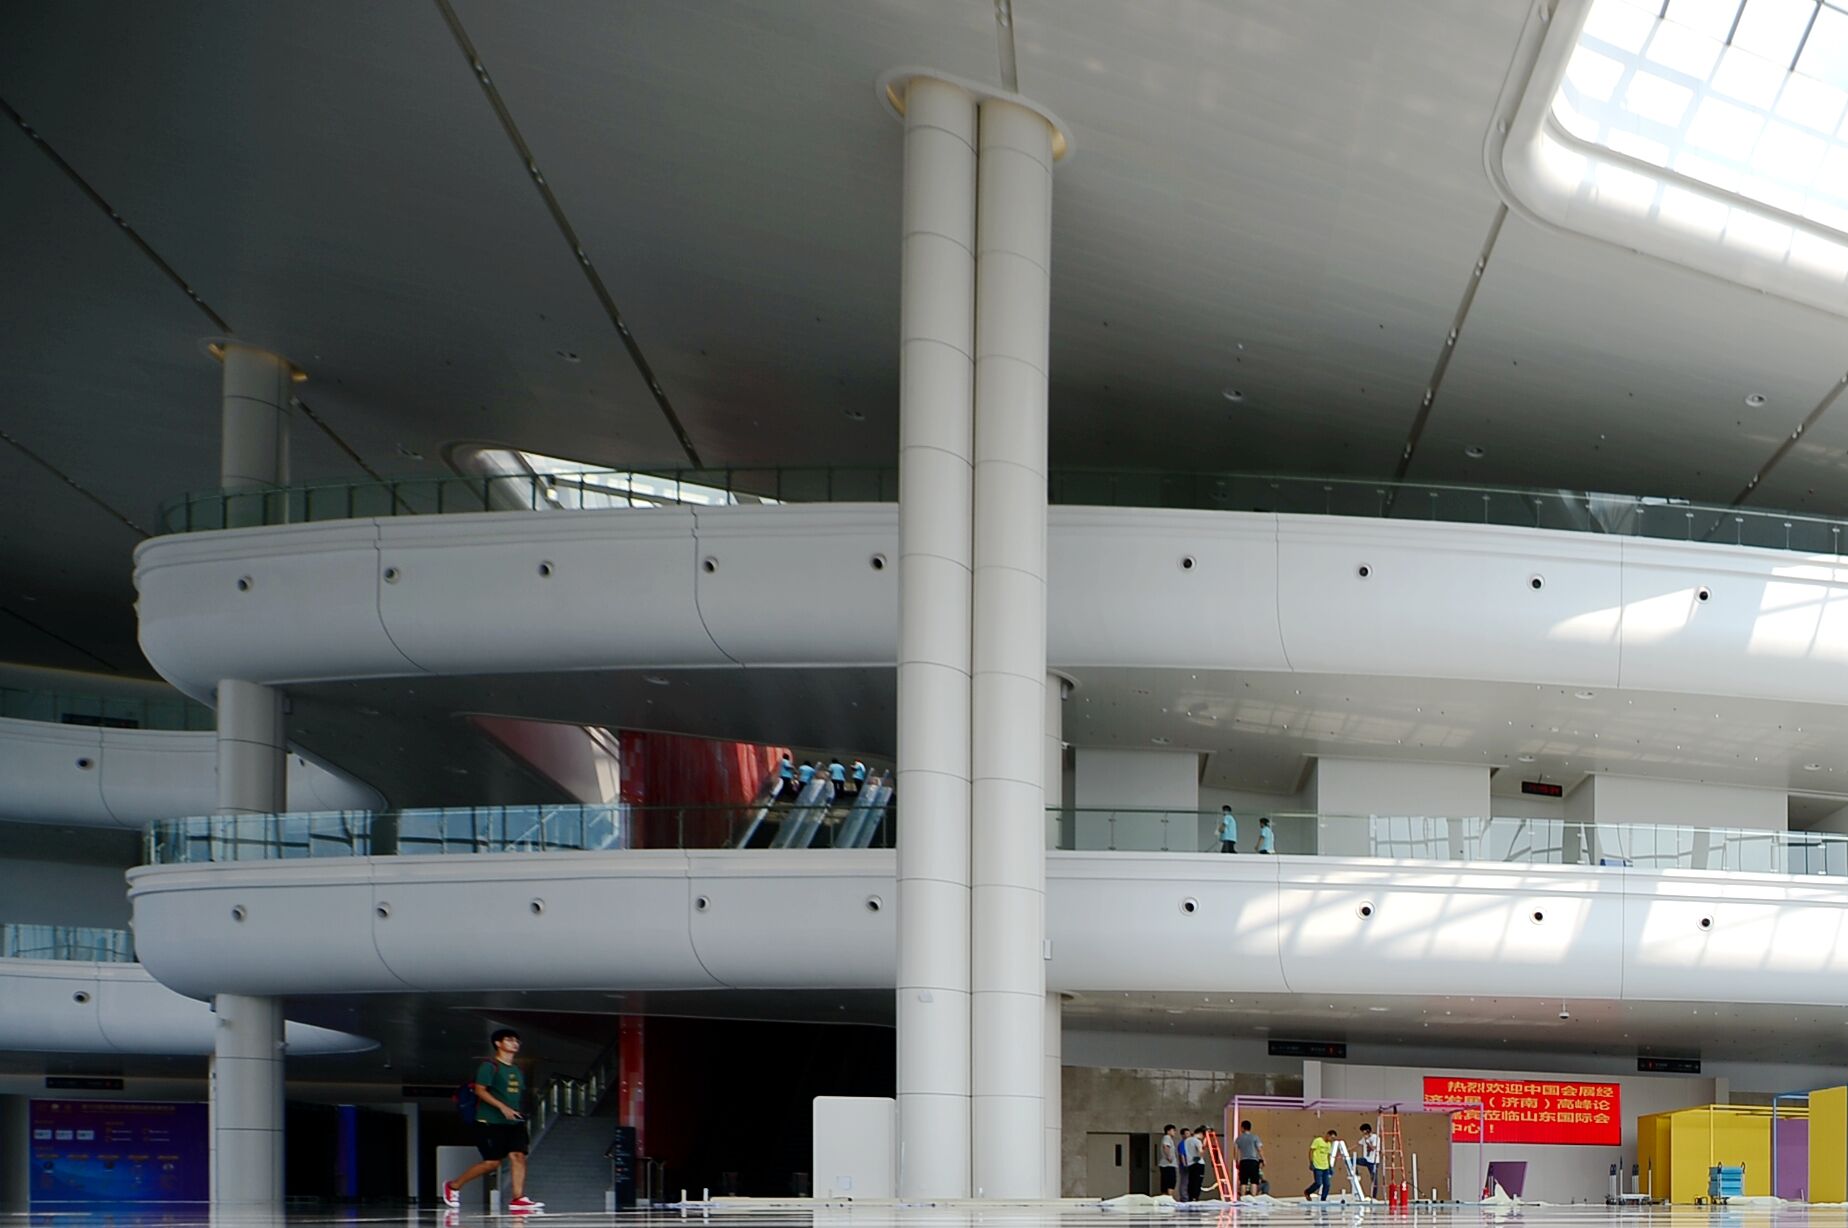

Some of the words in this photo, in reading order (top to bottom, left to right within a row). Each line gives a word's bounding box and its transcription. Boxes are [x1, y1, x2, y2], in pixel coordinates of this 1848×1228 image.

[1447, 1081, 1614, 1098] 热烈欢迎中国会展经
